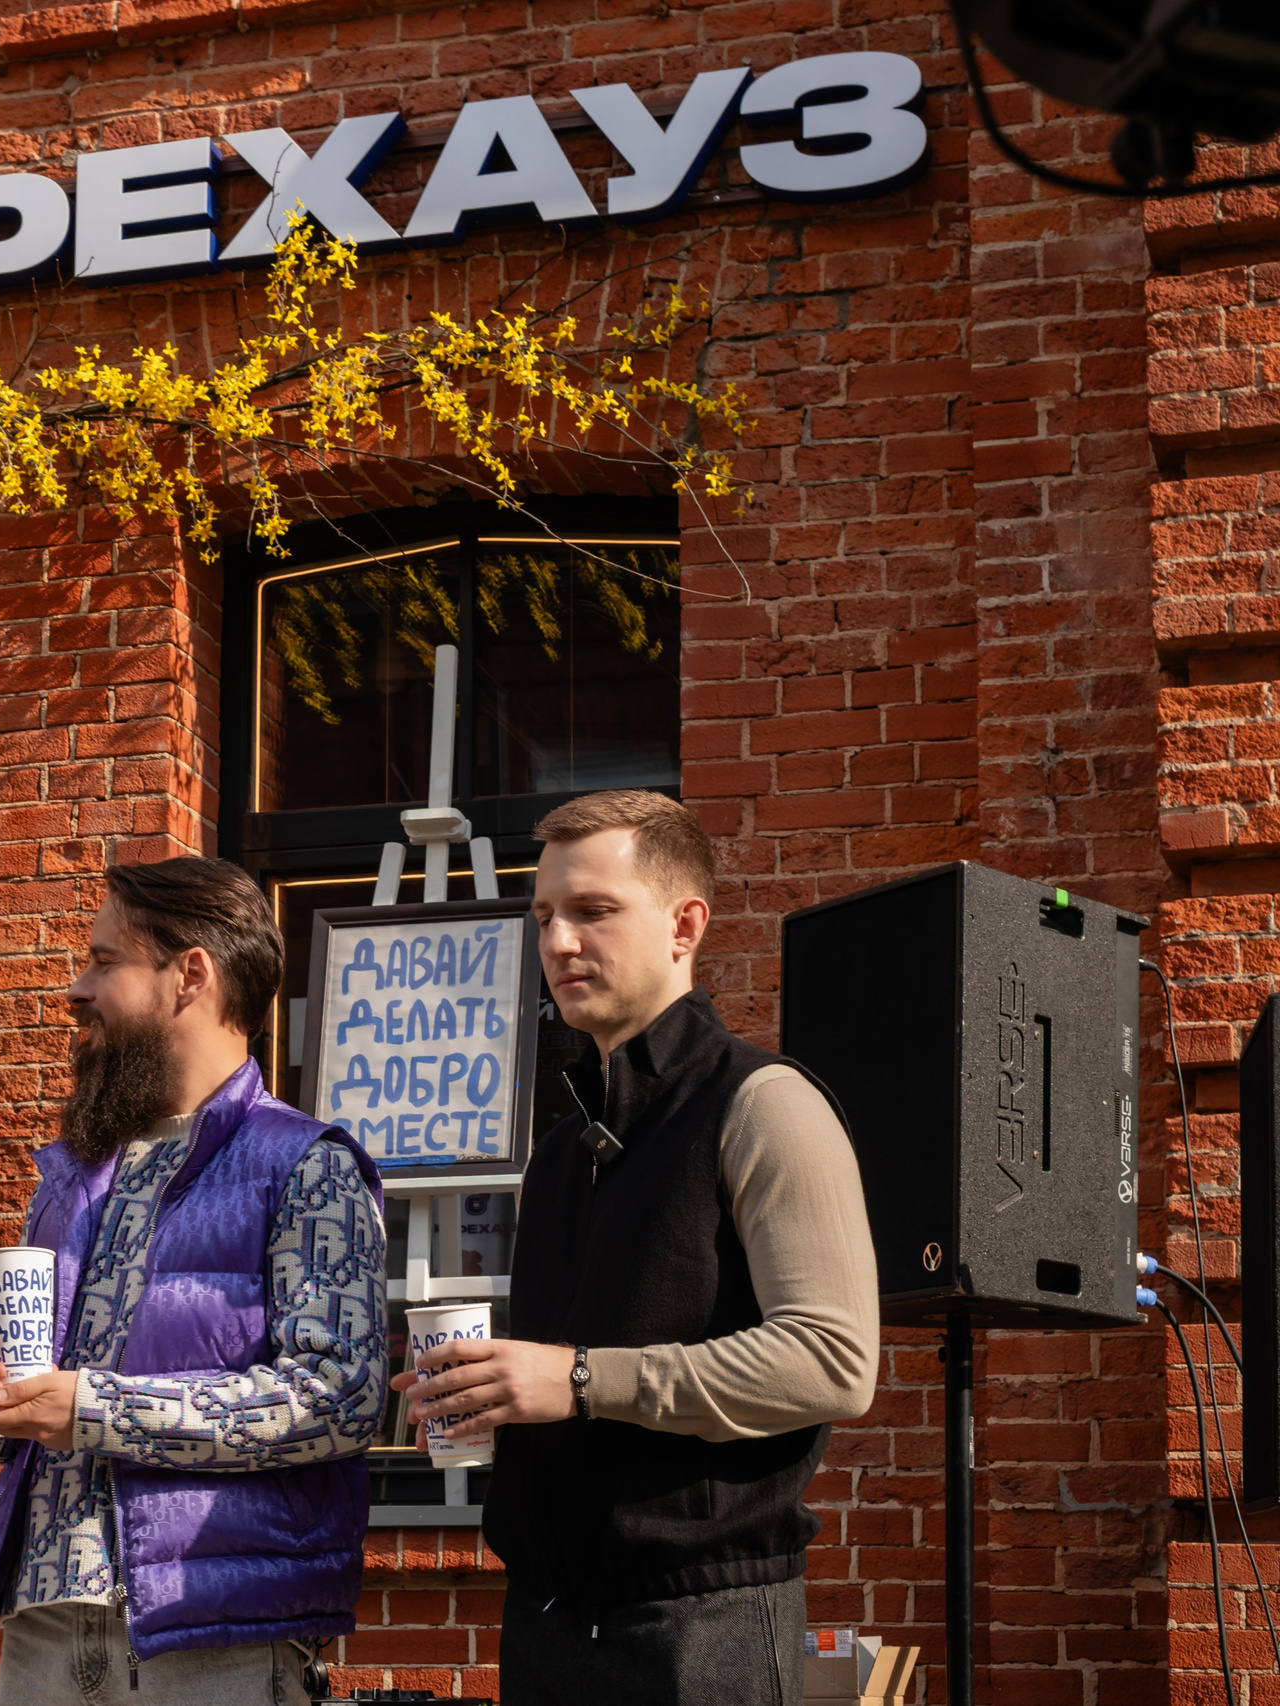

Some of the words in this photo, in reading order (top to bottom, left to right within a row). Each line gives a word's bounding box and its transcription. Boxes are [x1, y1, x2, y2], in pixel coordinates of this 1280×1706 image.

[341, 922, 504, 996] ДАВАЙ
[337, 997, 506, 1046] ДЕЛАТЬ
[330, 1052, 502, 1111] ДОБРО
